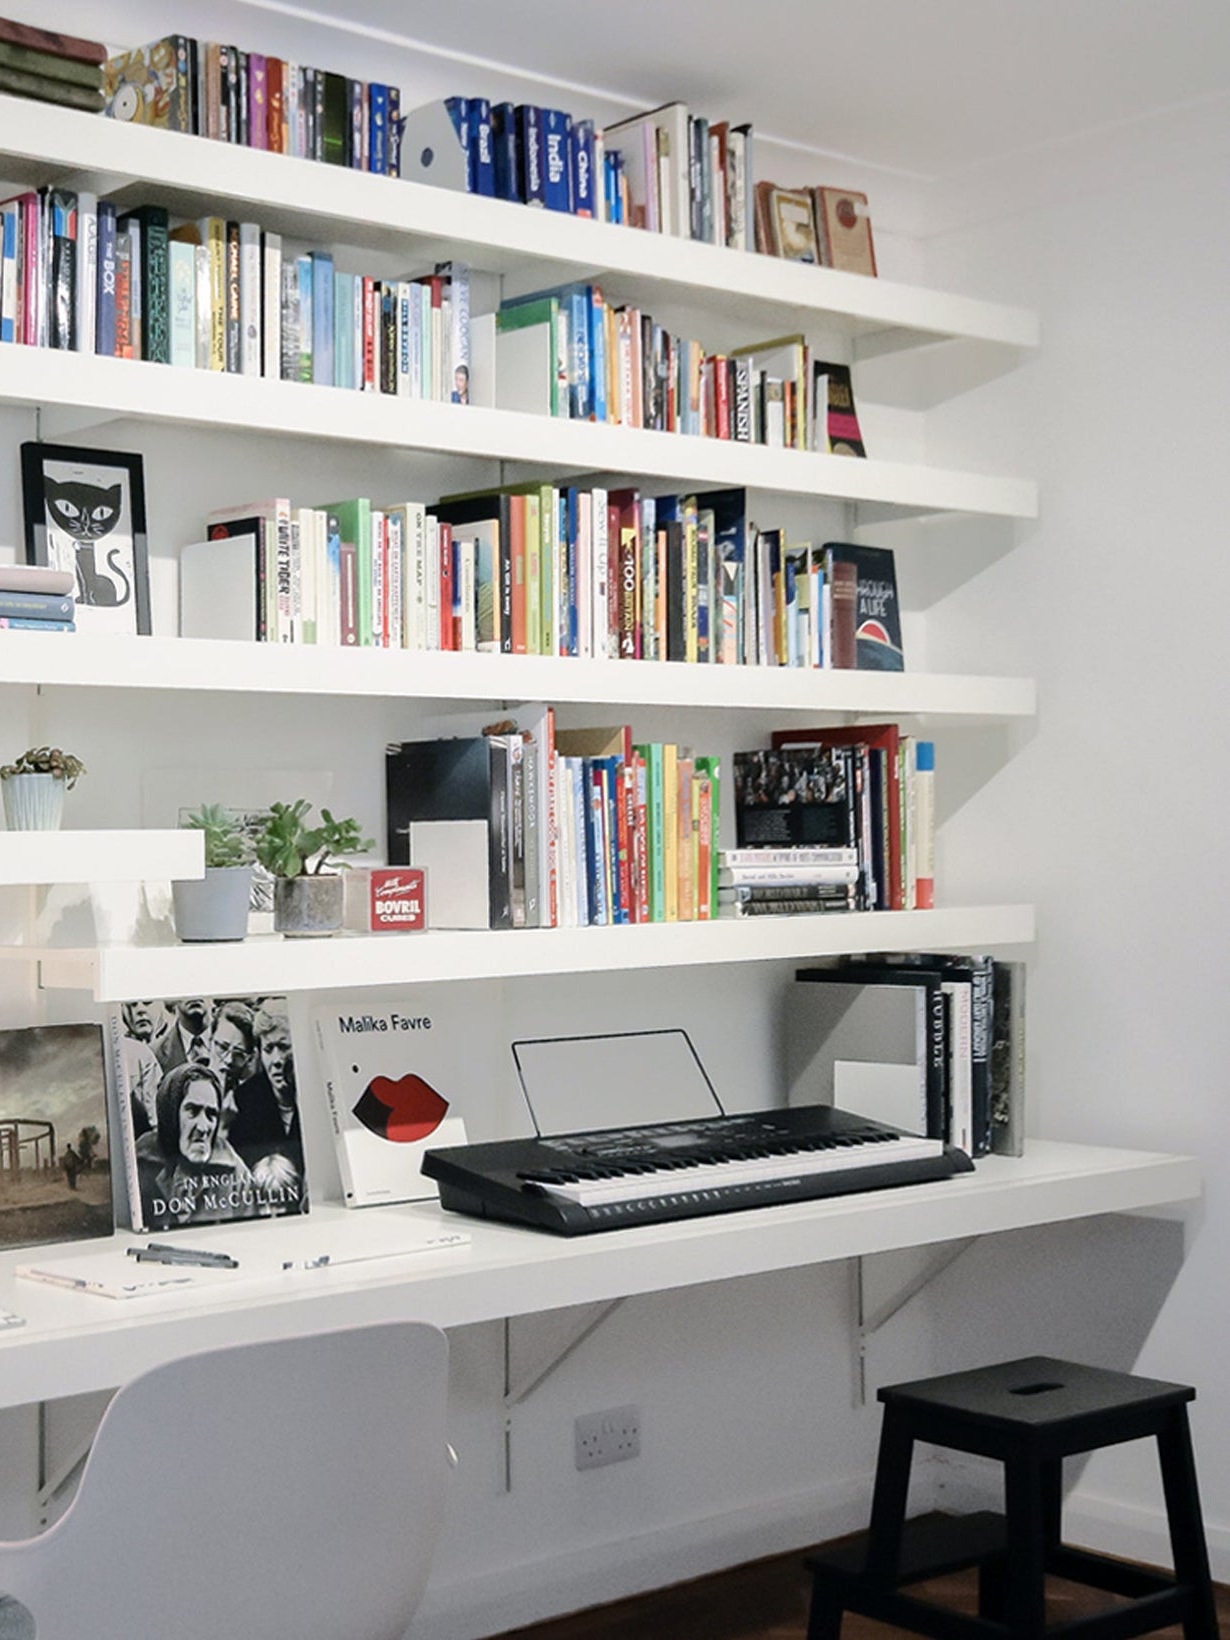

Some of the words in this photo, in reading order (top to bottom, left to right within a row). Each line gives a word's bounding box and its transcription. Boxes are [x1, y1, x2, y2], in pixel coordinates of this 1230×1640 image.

[478, 123, 490, 164] Brazil
[528, 127, 540, 191] Indonesia
[547, 134, 563, 183] India
[578, 150, 588, 198] China
[103, 259, 115, 295] BOX
[229, 283, 239, 322] CAINE
[459, 308, 469, 361] COOGAN
[736, 370, 749, 439] SPANISH
[416, 512, 422, 529] ON
[598, 501, 607, 533] Sew
[277, 526, 291, 557] WHITE
[598, 537, 607, 546] It
[277, 561, 291, 595] TIGER
[503, 559, 510, 571] AA
[596, 552, 607, 576] Up
[527, 755, 535, 828] HAWKSMOOR
[375, 899, 421, 914] BOVRIL
[111, 1016, 120, 1044] DON
[338, 1015, 389, 1034] Malika
[390, 1013, 432, 1031] Favre
[932, 989, 944, 1068] HUBBLE
[960, 989, 968, 1058] MODERN
[182, 1177, 199, 1191] IN
[202, 1169, 268, 1189] ENGLAND
[153, 1196, 197, 1217] DON
[204, 1185, 300, 1211] McCULLIN
